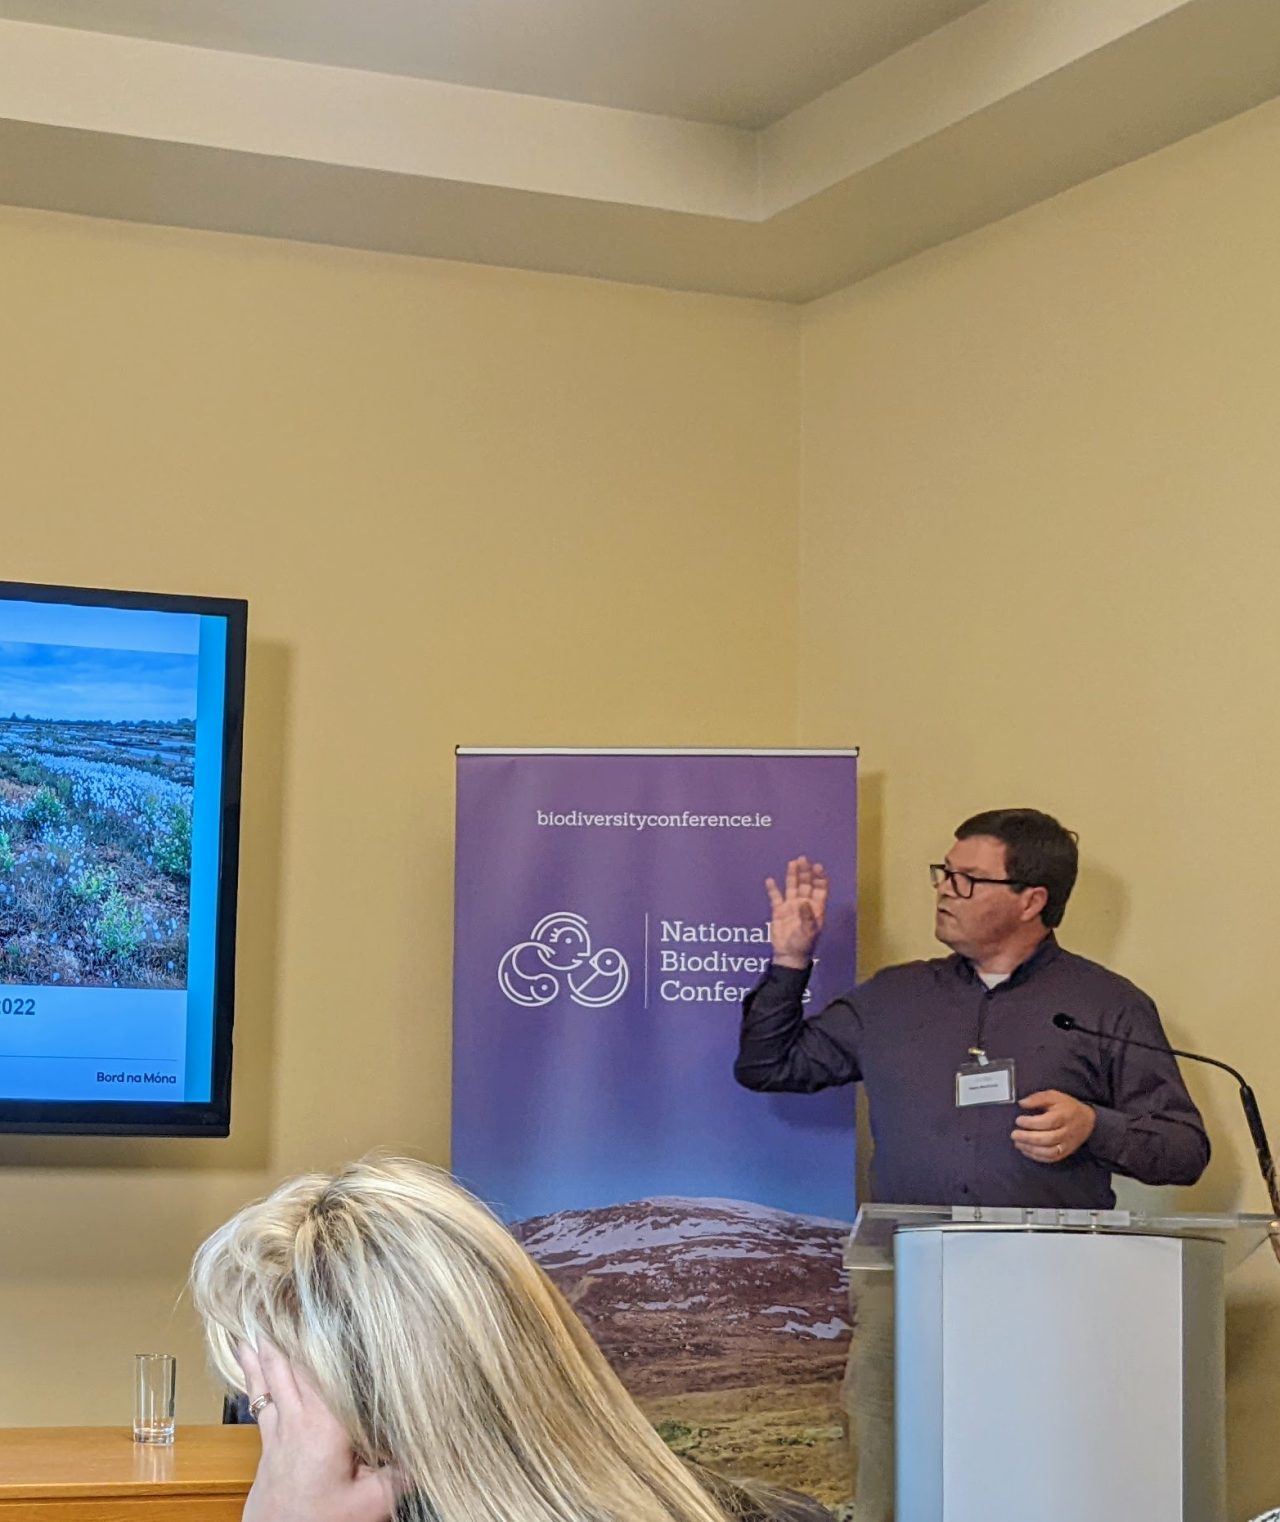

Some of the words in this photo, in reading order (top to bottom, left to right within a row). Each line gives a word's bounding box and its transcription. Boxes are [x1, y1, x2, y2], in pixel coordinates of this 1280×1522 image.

[536, 810, 772, 831] biodiversityconference.ie
[660, 921, 772, 943] National
[660, 951, 819, 974] Biodiver
[660, 980, 811, 1002] Confere
[96, 1071, 124, 1083] Bord
[126, 1075, 141, 1083] na
[143, 1071, 177, 1084] Móna
